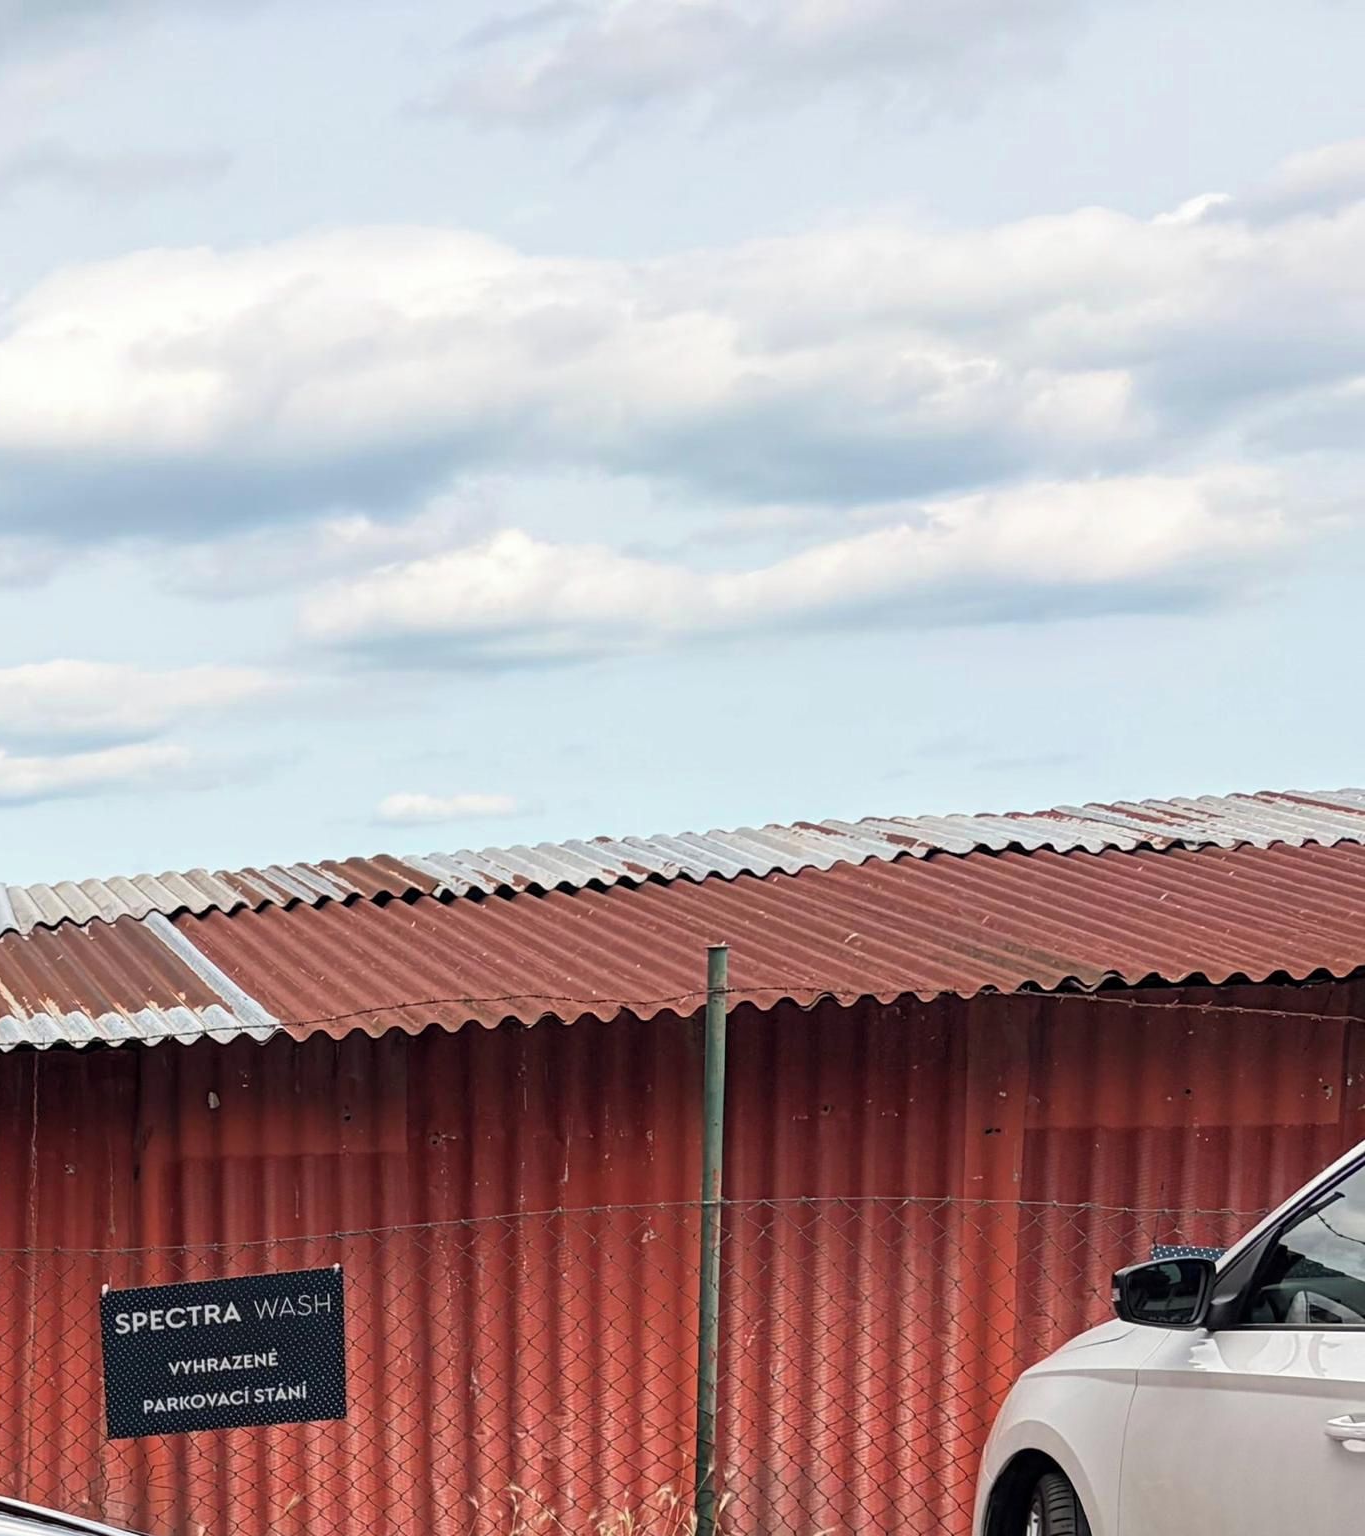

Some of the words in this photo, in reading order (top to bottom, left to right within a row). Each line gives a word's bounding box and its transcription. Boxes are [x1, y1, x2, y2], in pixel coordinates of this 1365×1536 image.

[115, 1301, 242, 1335] SPECTRA
[254, 1293, 332, 1320] WASH
[168, 1348, 279, 1376] VYHRAZENÉ
[143, 1386, 249, 1415] PARKOVACÍ
[254, 1380, 307, 1405] STÁNÍ
